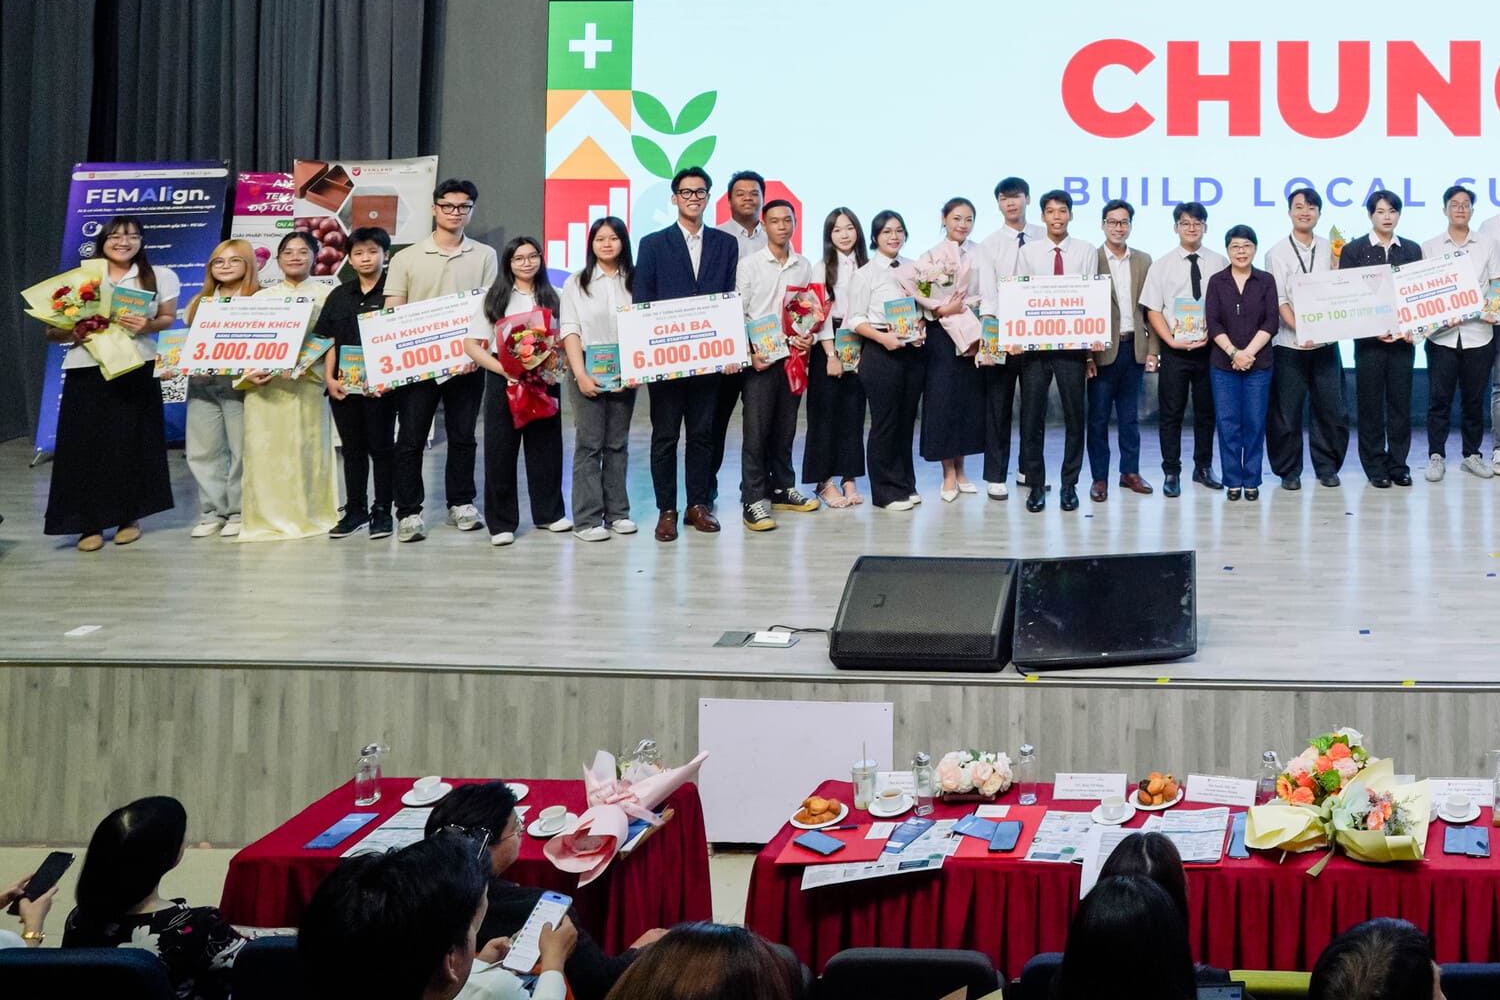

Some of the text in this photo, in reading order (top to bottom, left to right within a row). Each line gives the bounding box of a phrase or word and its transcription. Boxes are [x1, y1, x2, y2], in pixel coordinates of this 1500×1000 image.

[85, 185, 211, 205] FEMAlign.
[690, 318, 713, 332] BA
[1301, 308, 1348, 324] TOP 100
[1005, 317, 1106, 337] 10.000.000
[193, 341, 290, 361] 3.000.000
[633, 337, 736, 369] 6.000.000
